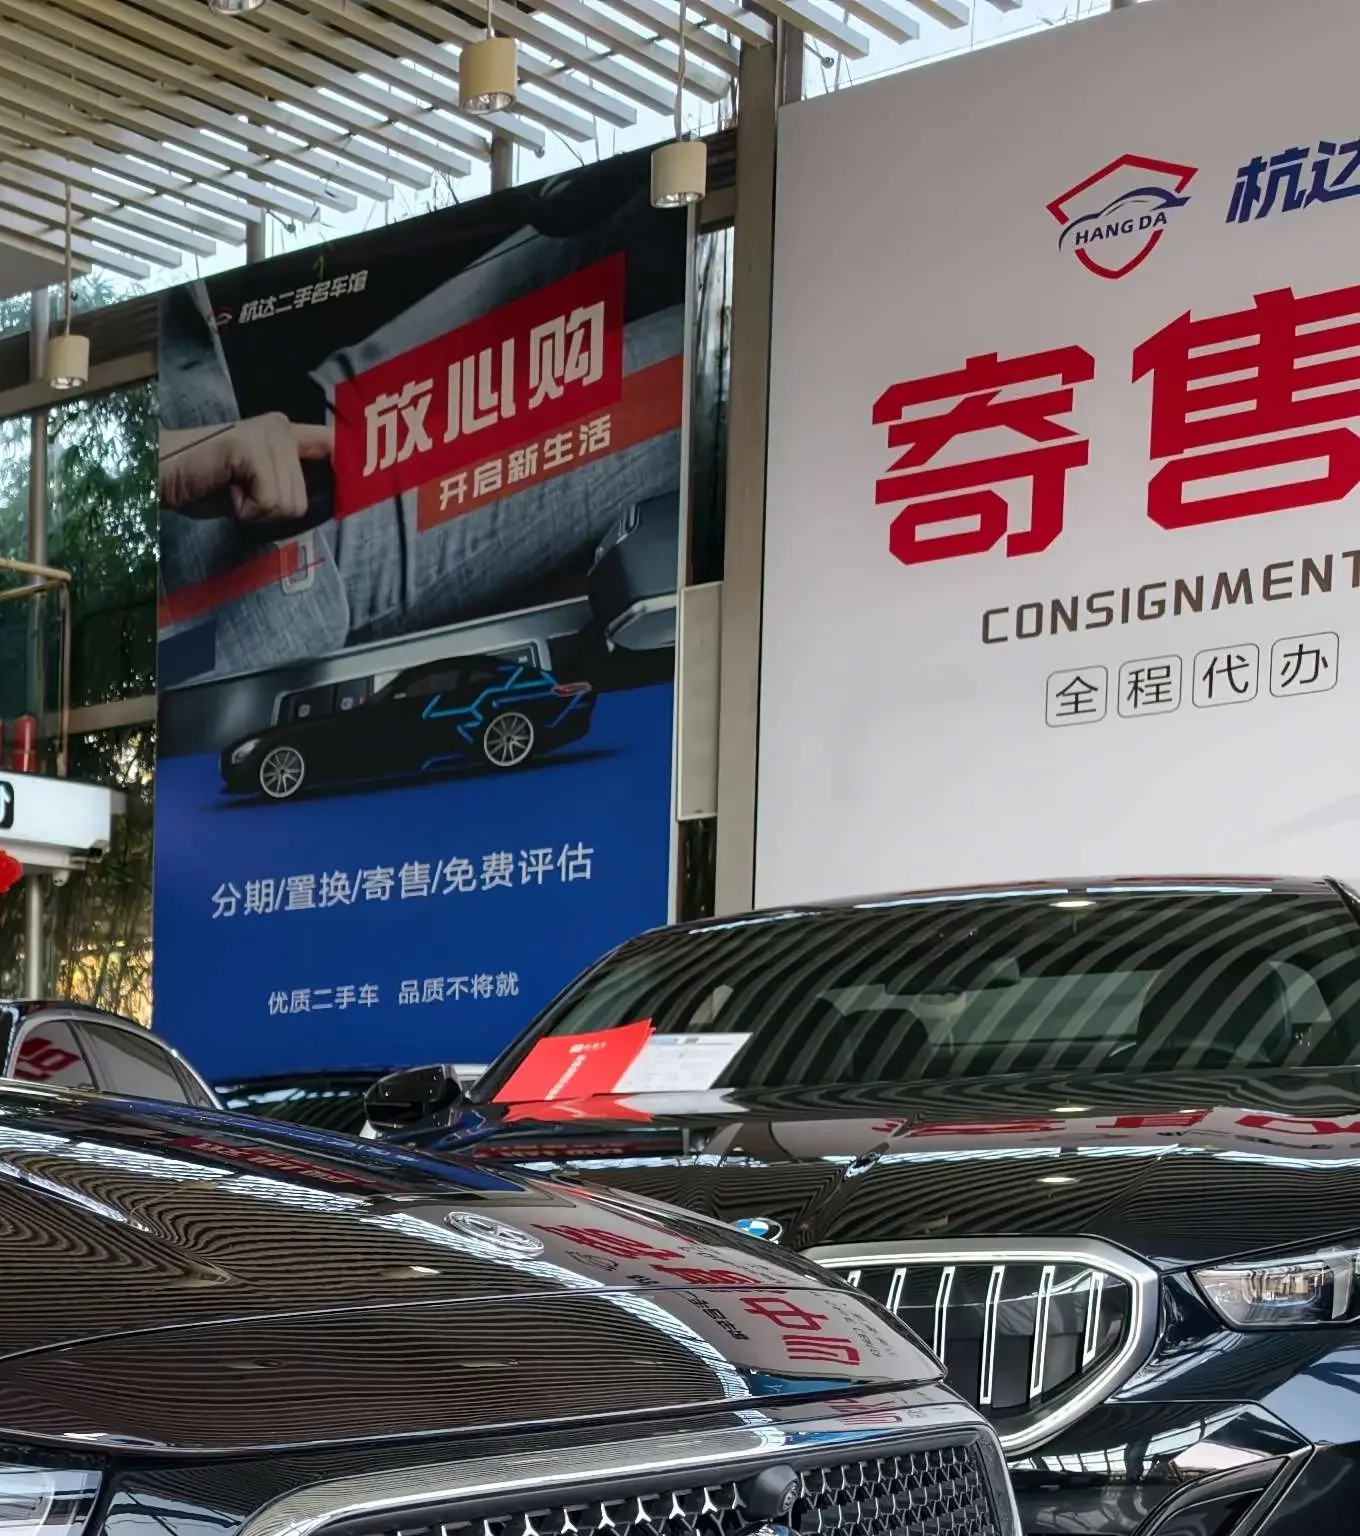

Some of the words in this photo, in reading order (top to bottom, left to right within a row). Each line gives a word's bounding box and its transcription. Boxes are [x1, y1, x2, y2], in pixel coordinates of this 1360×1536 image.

[1074, 219, 1135, 246] HANG
[1138, 211, 1168, 231] DA
[237, 269, 370, 325] 杭达二手名车馆
[363, 299, 608, 477] 放心购
[871, 283, 1360, 566] 寄售
[438, 413, 614, 512] 开启新生活
[1054, 642, 1331, 718] 全程代办
[211, 840, 595, 920] 分期/置换/寄售/免费评估
[267, 982, 381, 1017] 优质二手车
[397, 970, 520, 1007] 品质不将就
